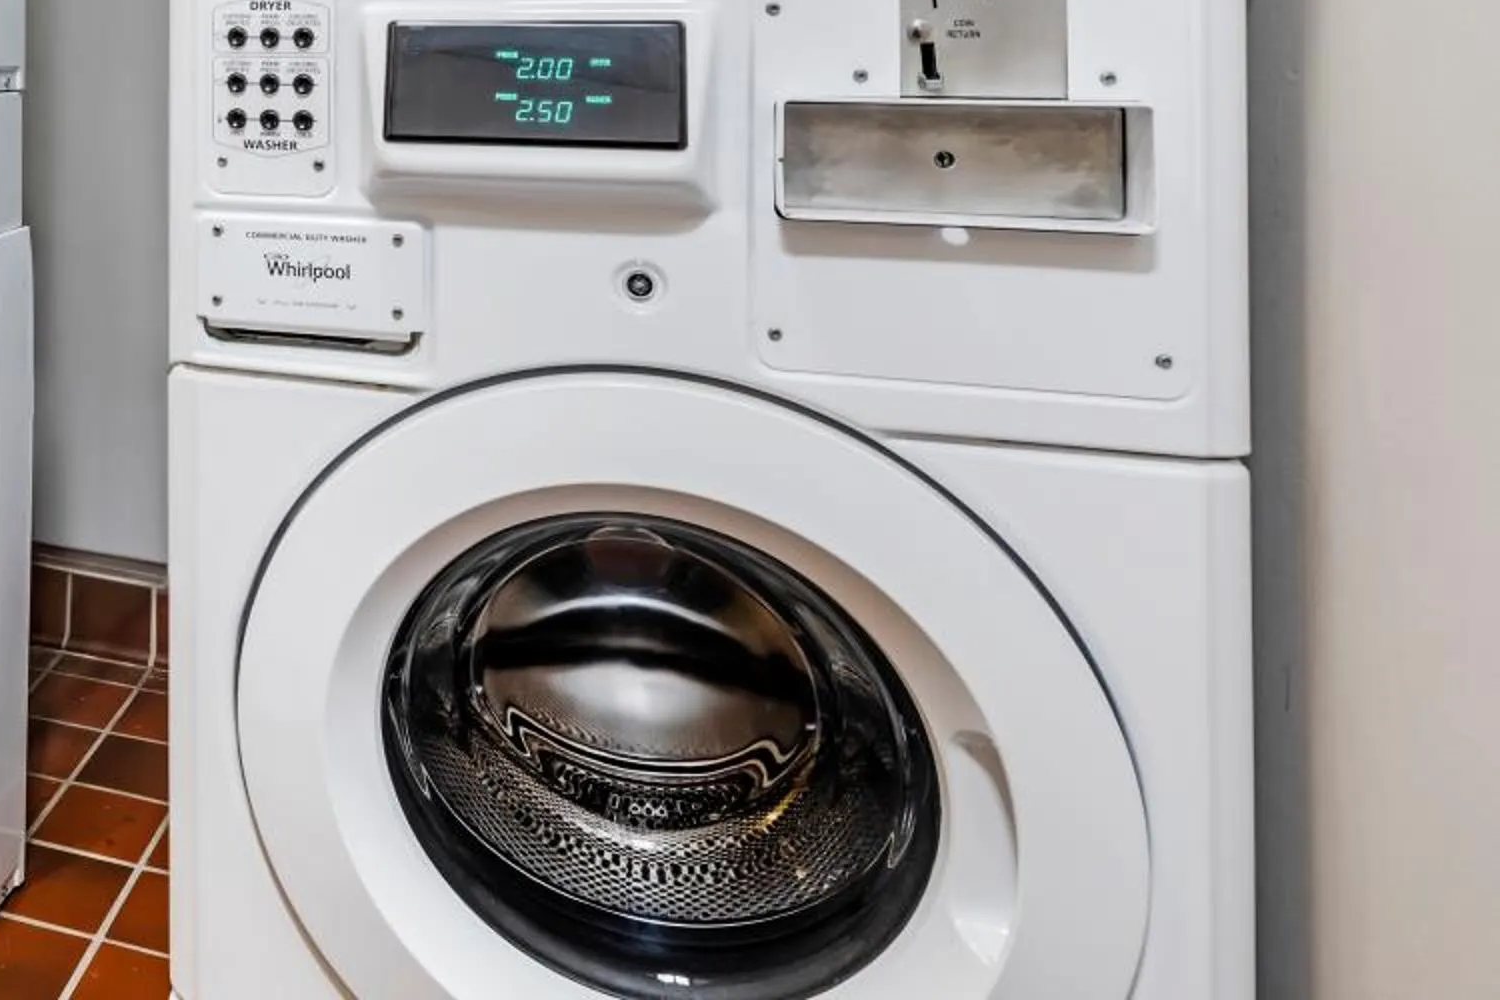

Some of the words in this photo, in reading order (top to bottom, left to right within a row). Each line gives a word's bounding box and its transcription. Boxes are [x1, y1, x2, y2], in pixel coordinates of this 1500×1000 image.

[249, 0, 291, 11] DRYER
[516, 57, 573, 80] 2.00
[515, 99, 573, 123] 2.50
[244, 139, 298, 151] WASHER
[266, 259, 351, 283] Whirlpool
